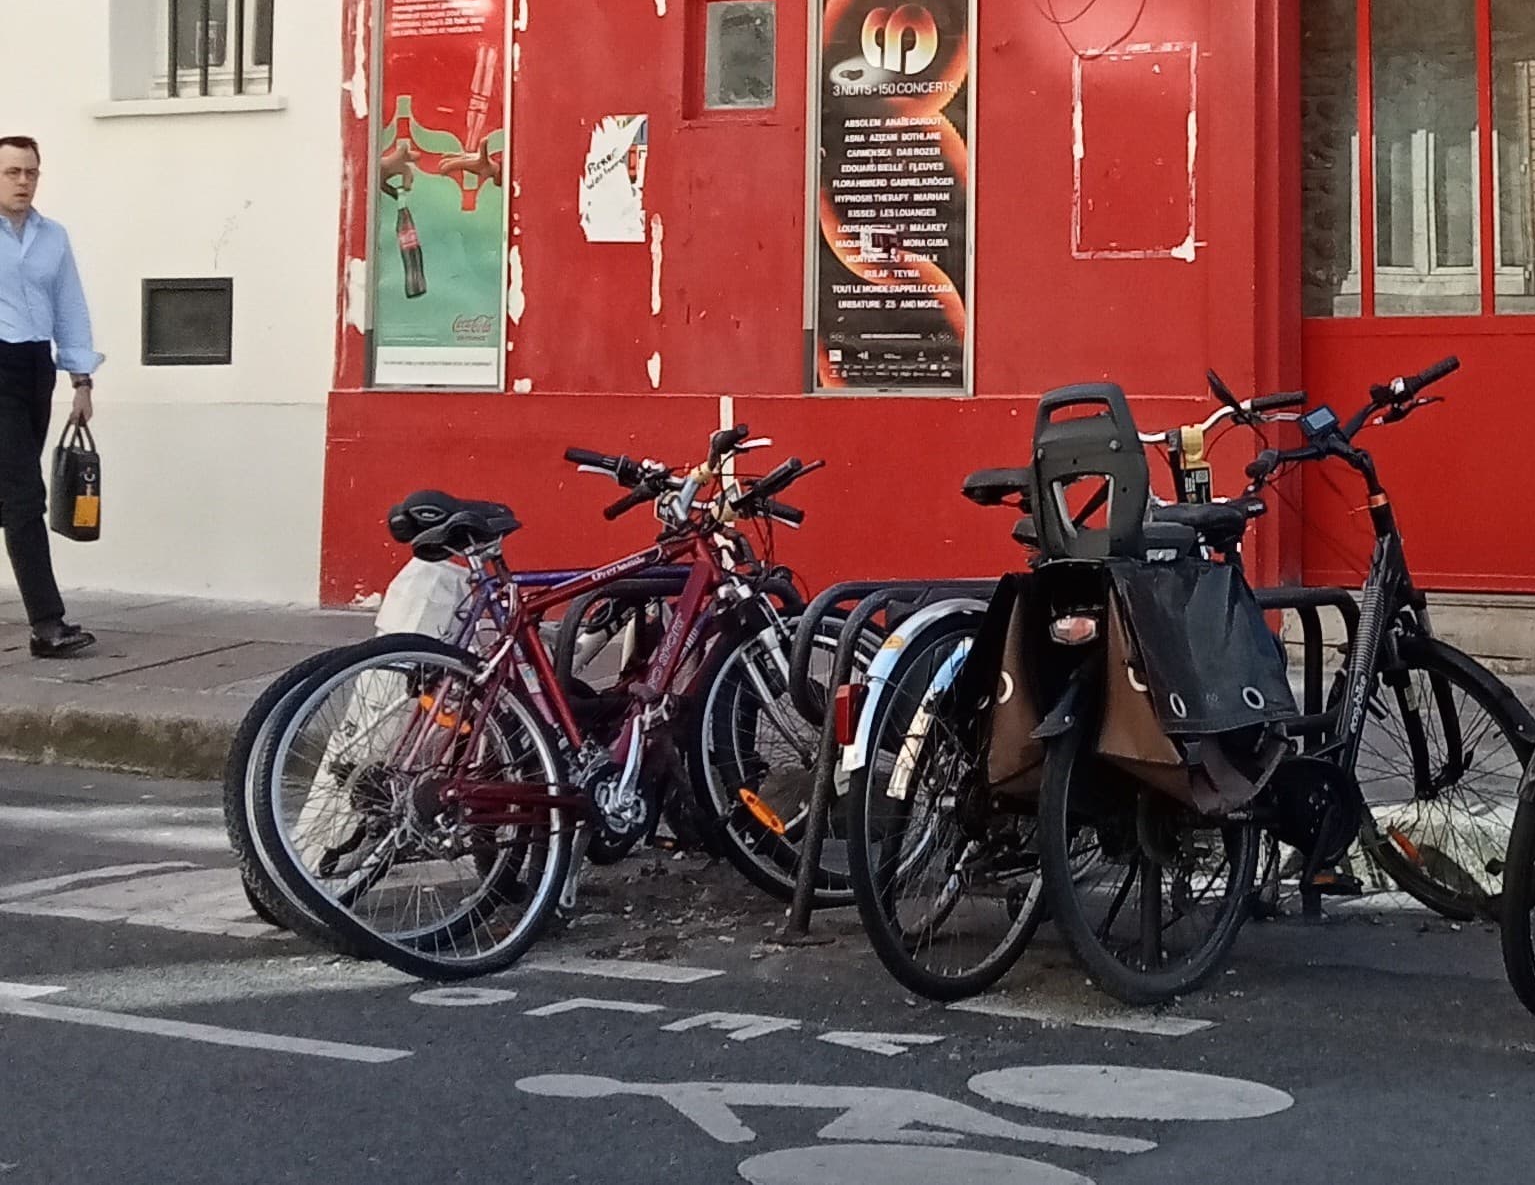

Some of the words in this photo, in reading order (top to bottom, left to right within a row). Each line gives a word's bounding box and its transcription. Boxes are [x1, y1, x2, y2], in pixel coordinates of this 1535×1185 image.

[833, 87, 841, 96] 3
[842, 85, 871, 95] NUITS
[878, 83, 895, 94] 150
[896, 81, 955, 93] CONCERTS
[1350, 674, 1367, 734] easybike
